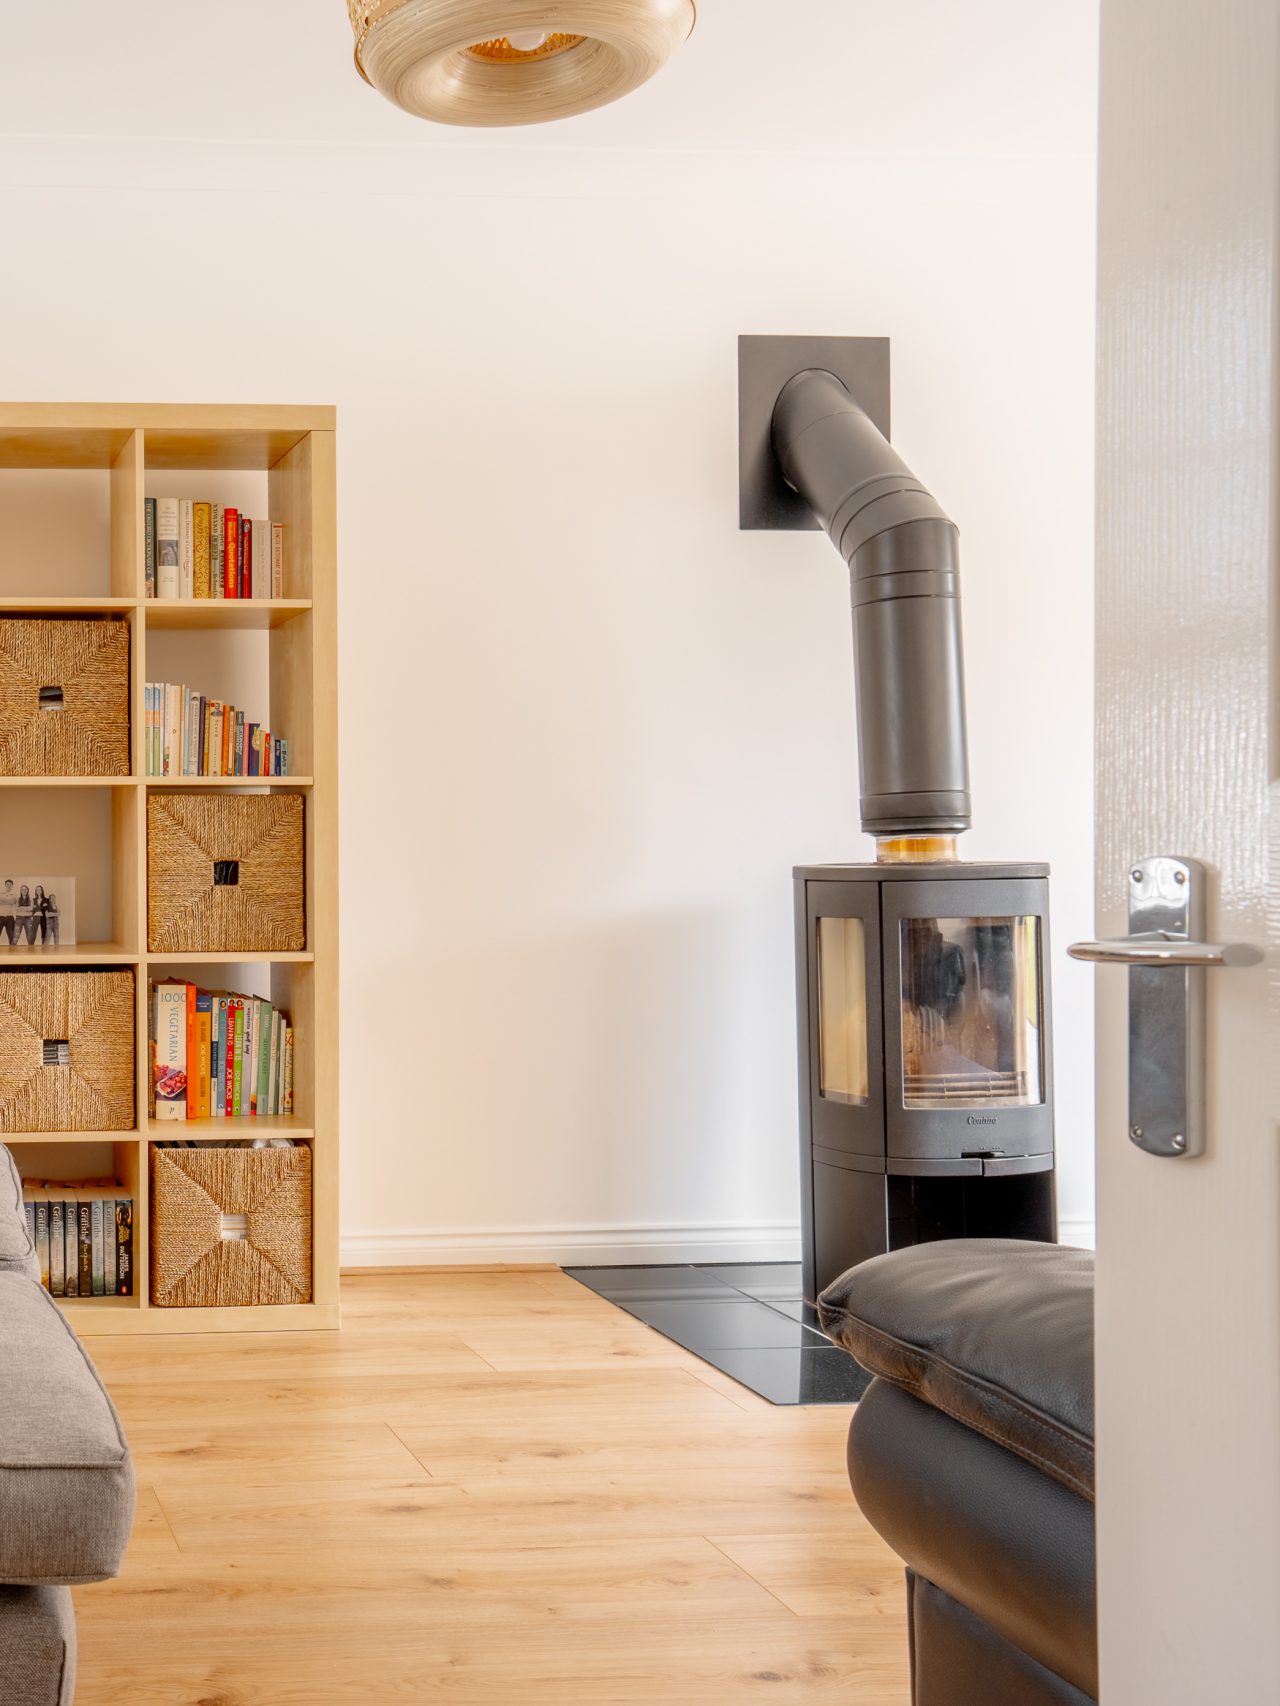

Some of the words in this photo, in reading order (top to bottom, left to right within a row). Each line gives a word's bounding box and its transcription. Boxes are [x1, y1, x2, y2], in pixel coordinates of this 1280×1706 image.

[169, 1008, 178, 1062] VEGETARIAN
[38, 1208, 46, 1240] Griffiths
[106, 1206, 114, 1238] Griffiths
